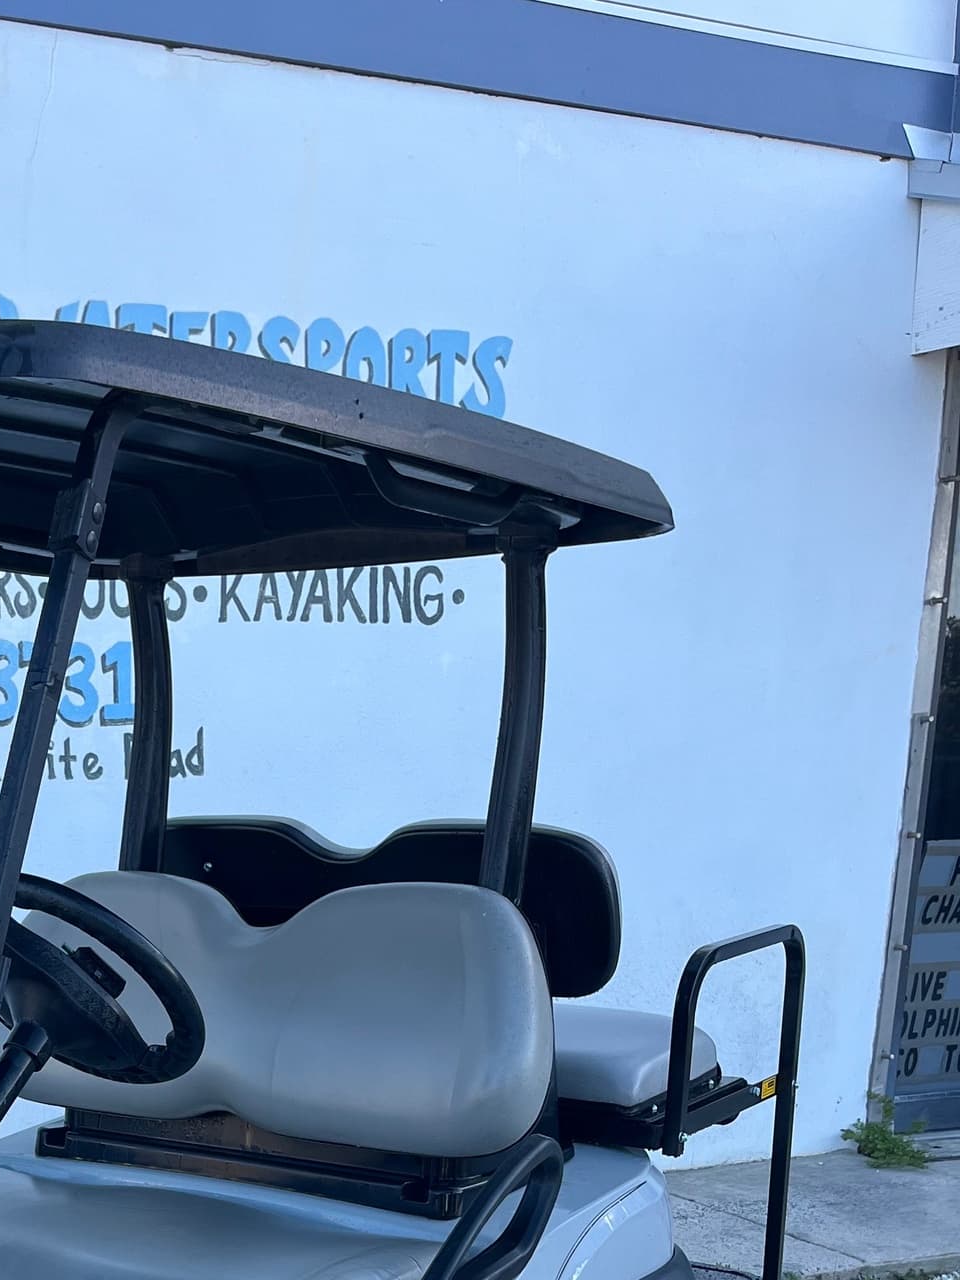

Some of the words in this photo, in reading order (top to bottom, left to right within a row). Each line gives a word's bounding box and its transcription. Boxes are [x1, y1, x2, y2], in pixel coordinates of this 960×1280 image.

[217, 563, 446, 626] KAYAKING
[45, 736, 103, 781] ite
[904, 971, 947, 1002] IVE
[900, 1007, 960, 1040] LPHI
